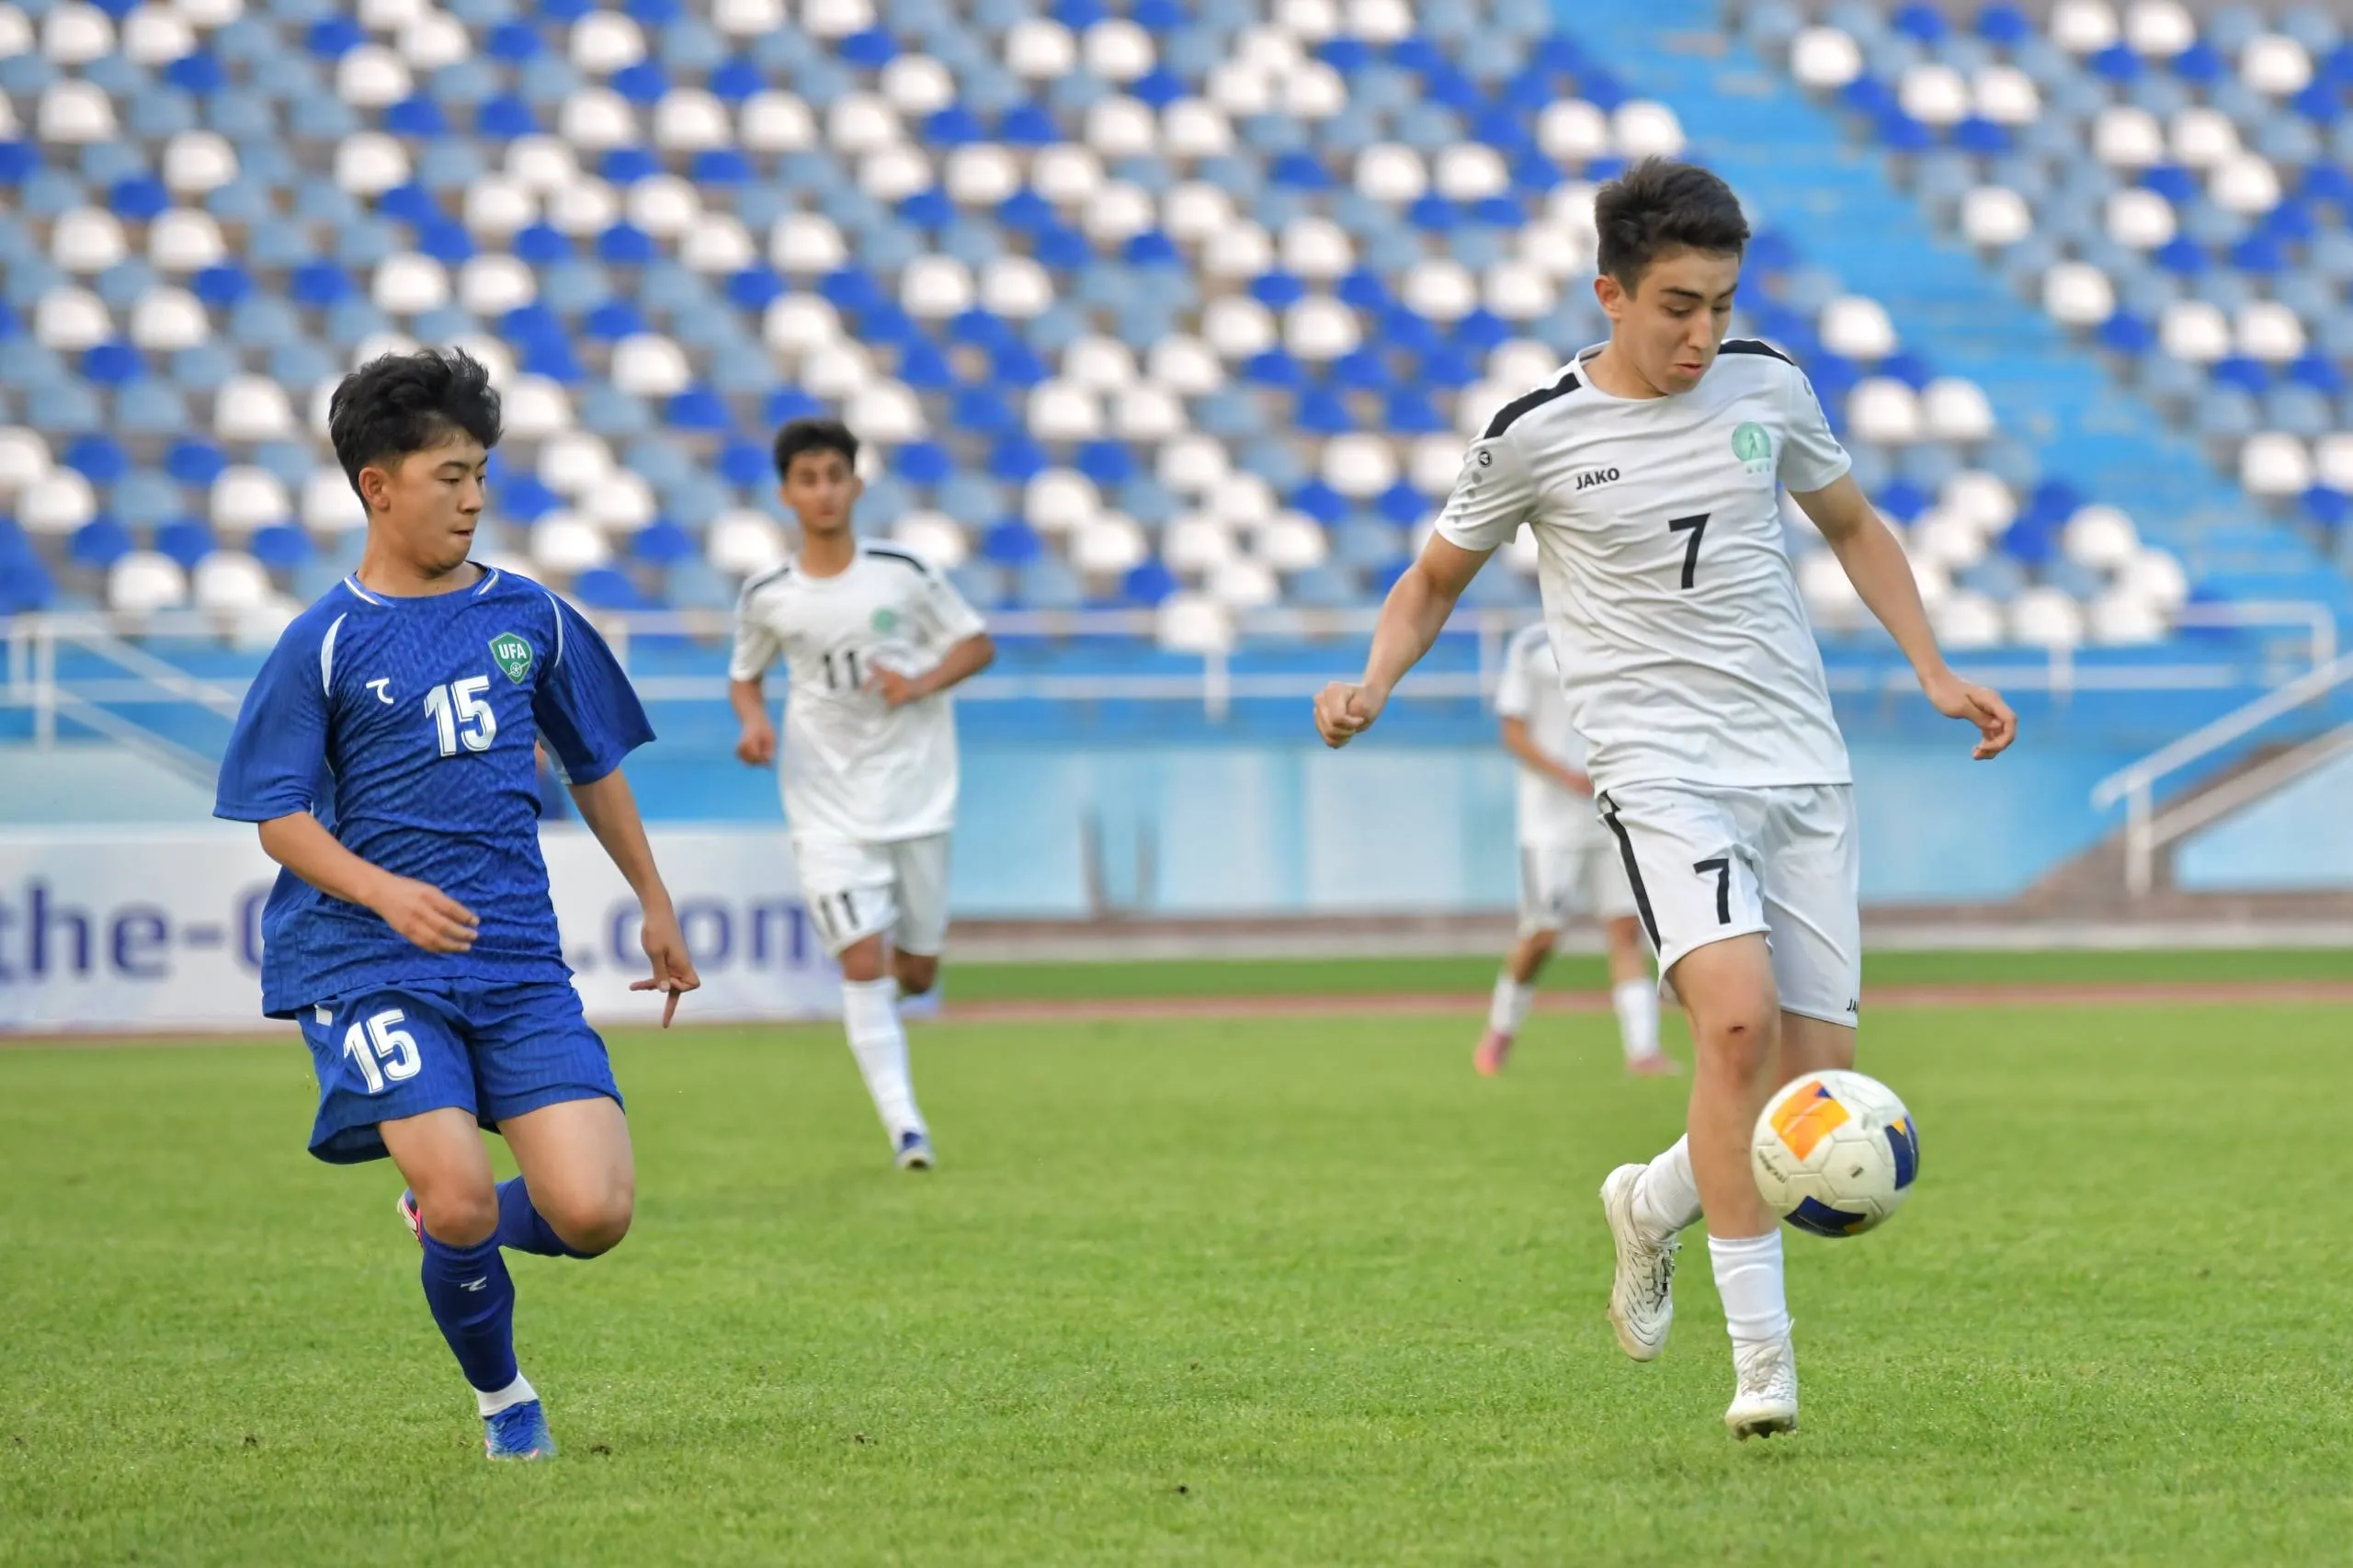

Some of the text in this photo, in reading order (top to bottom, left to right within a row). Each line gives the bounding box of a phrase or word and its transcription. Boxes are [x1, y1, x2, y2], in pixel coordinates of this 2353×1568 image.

[1575, 467, 1620, 490] JAKO
[1668, 513, 1711, 590] 7
[497, 643, 528, 660] UFA
[823, 647, 862, 691] 11
[423, 674, 497, 757] 15
[818, 890, 861, 939] 11
[1692, 858, 1732, 926] 7
[343, 1008, 422, 1095] 15
